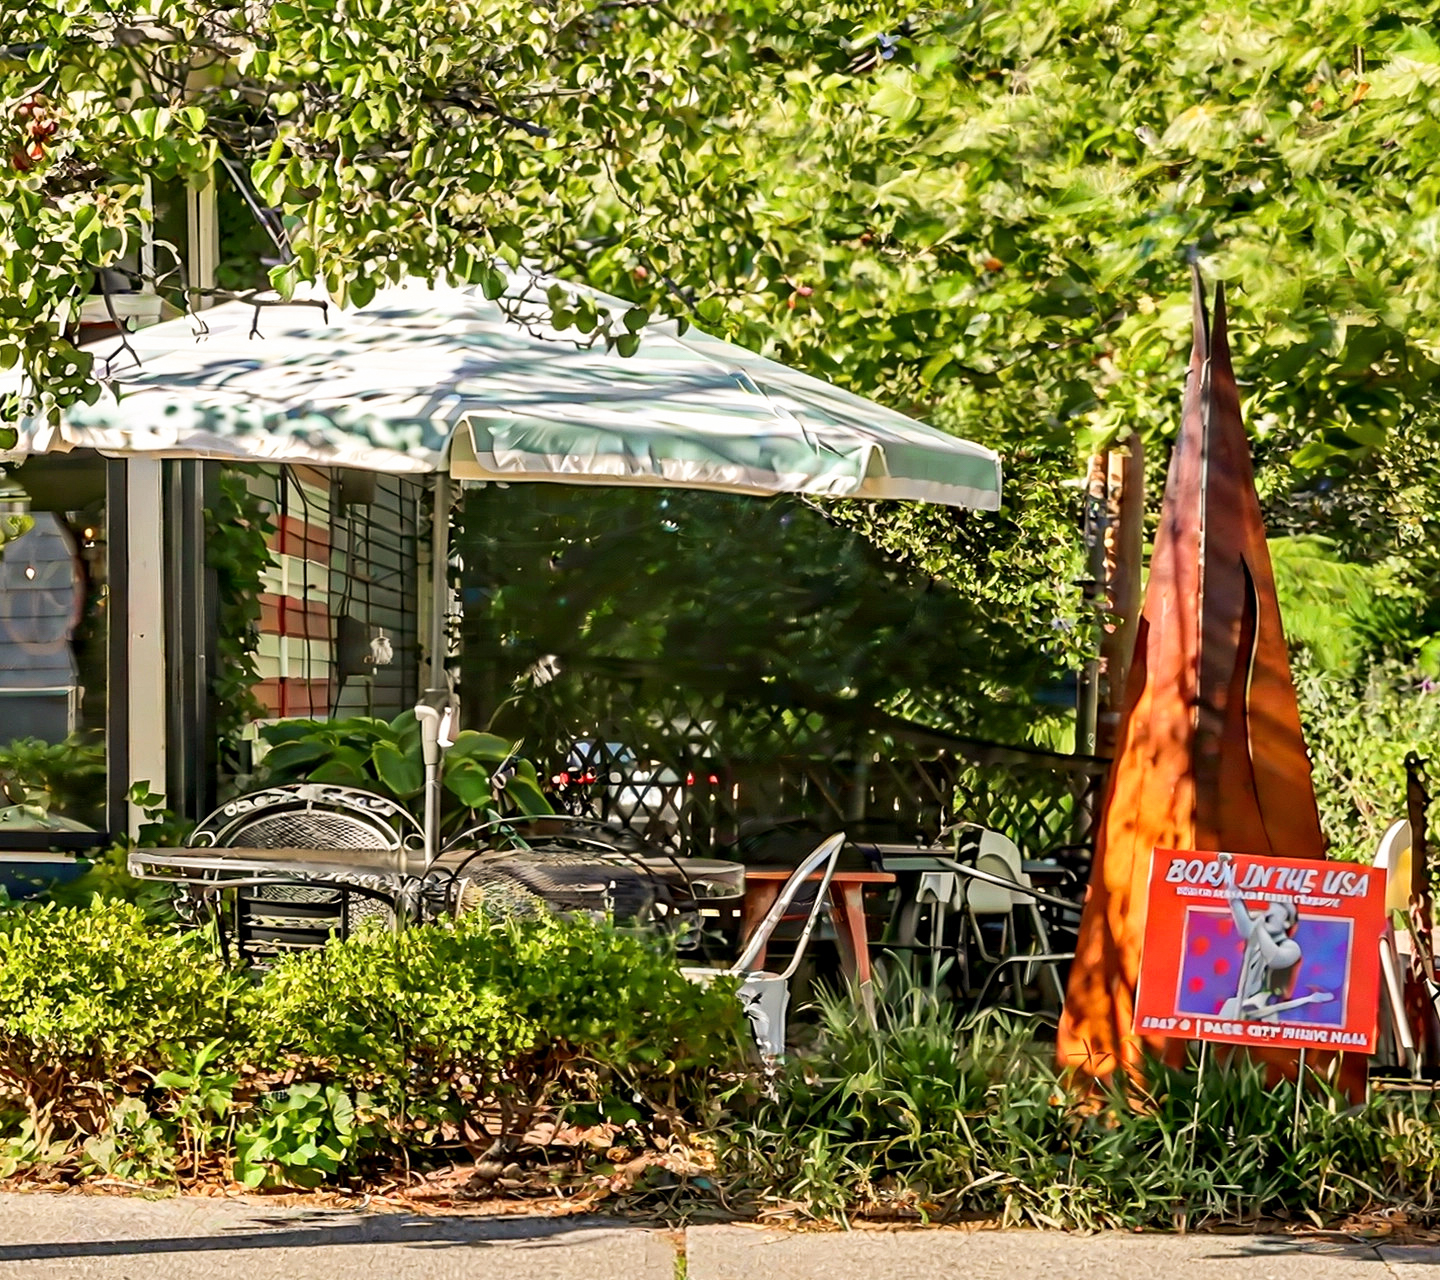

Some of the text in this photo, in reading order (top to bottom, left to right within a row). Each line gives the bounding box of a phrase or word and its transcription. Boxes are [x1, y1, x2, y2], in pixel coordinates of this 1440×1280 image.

[1166, 859, 1370, 897] BORN IN THE USA
